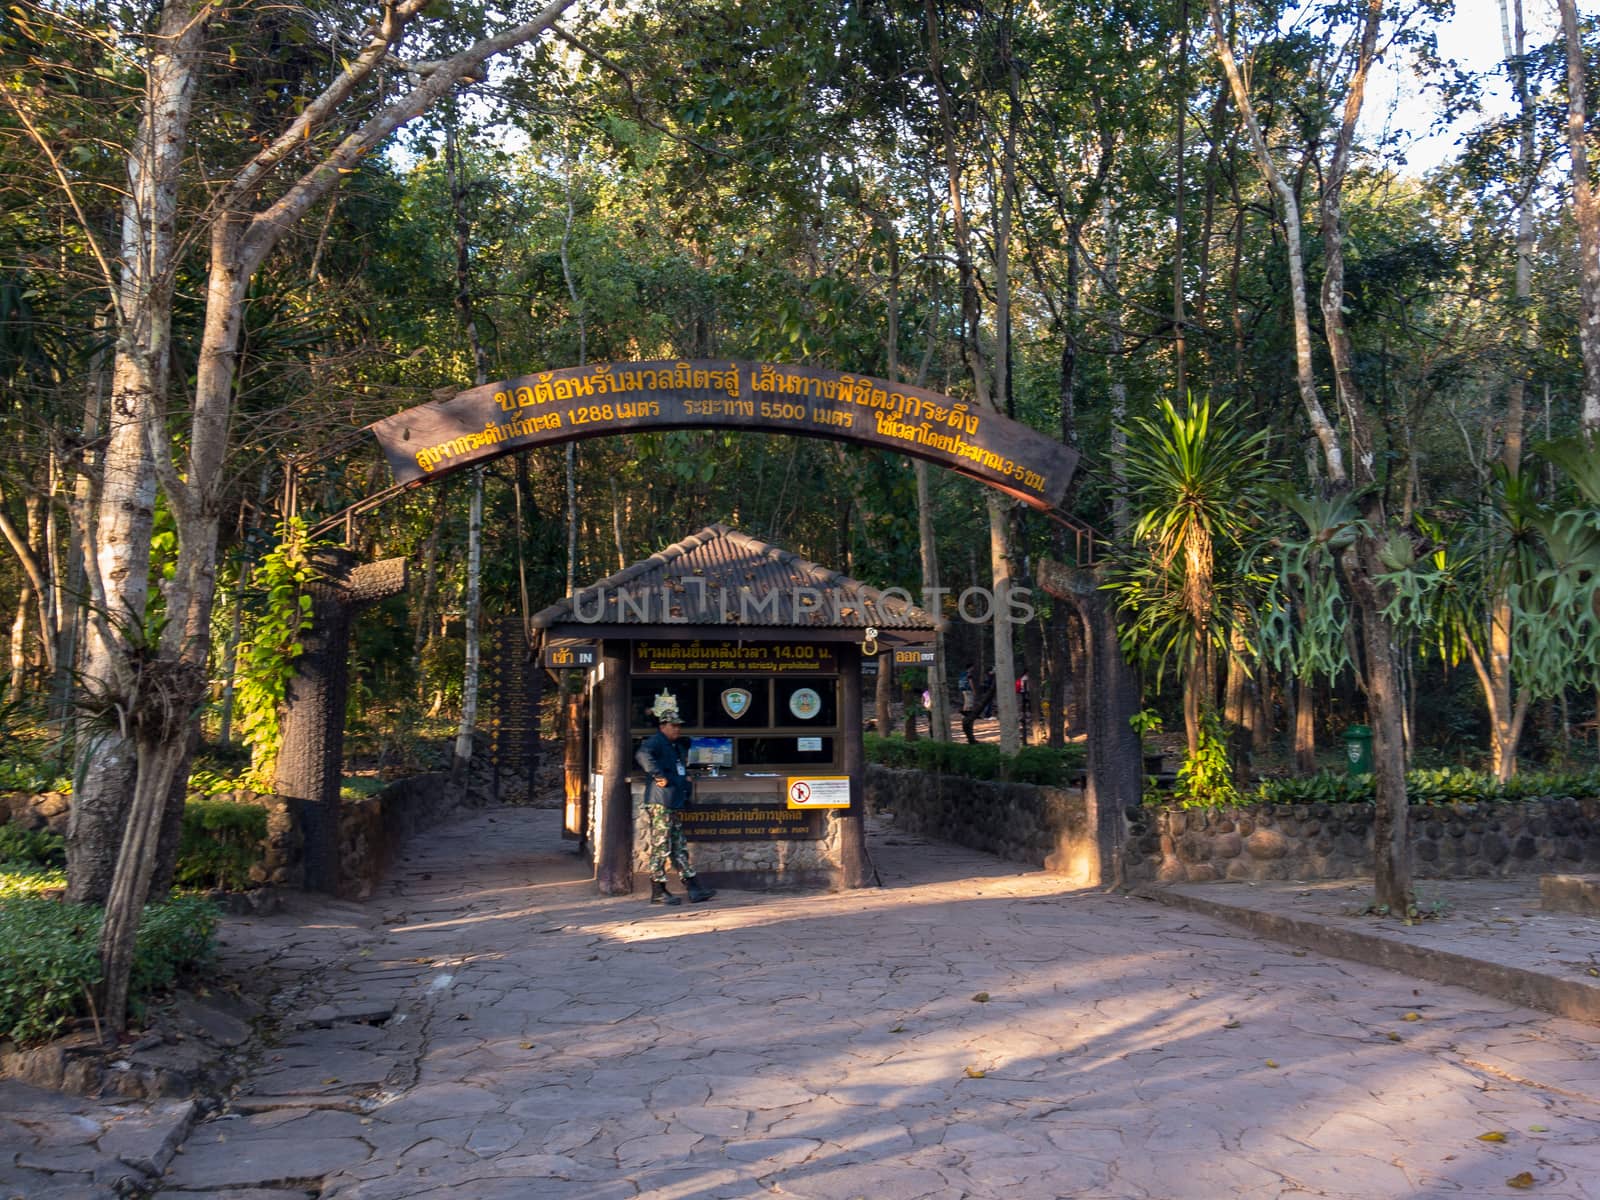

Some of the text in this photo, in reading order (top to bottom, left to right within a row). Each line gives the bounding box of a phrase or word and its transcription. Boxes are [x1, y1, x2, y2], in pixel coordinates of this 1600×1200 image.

[494, 362, 980, 436] ขอต้อนรับมวลมิตรสู่ เส้นทางพิชิตภูกระดึง
[616, 400, 660, 420] เมตร
[683, 399, 754, 417] ระยะทาง
[813, 407, 854, 428] เมตร
[552, 647, 593, 664] เข้า IN
[772, 645, 815, 659] 14.00
[895, 650, 921, 663] ออก
